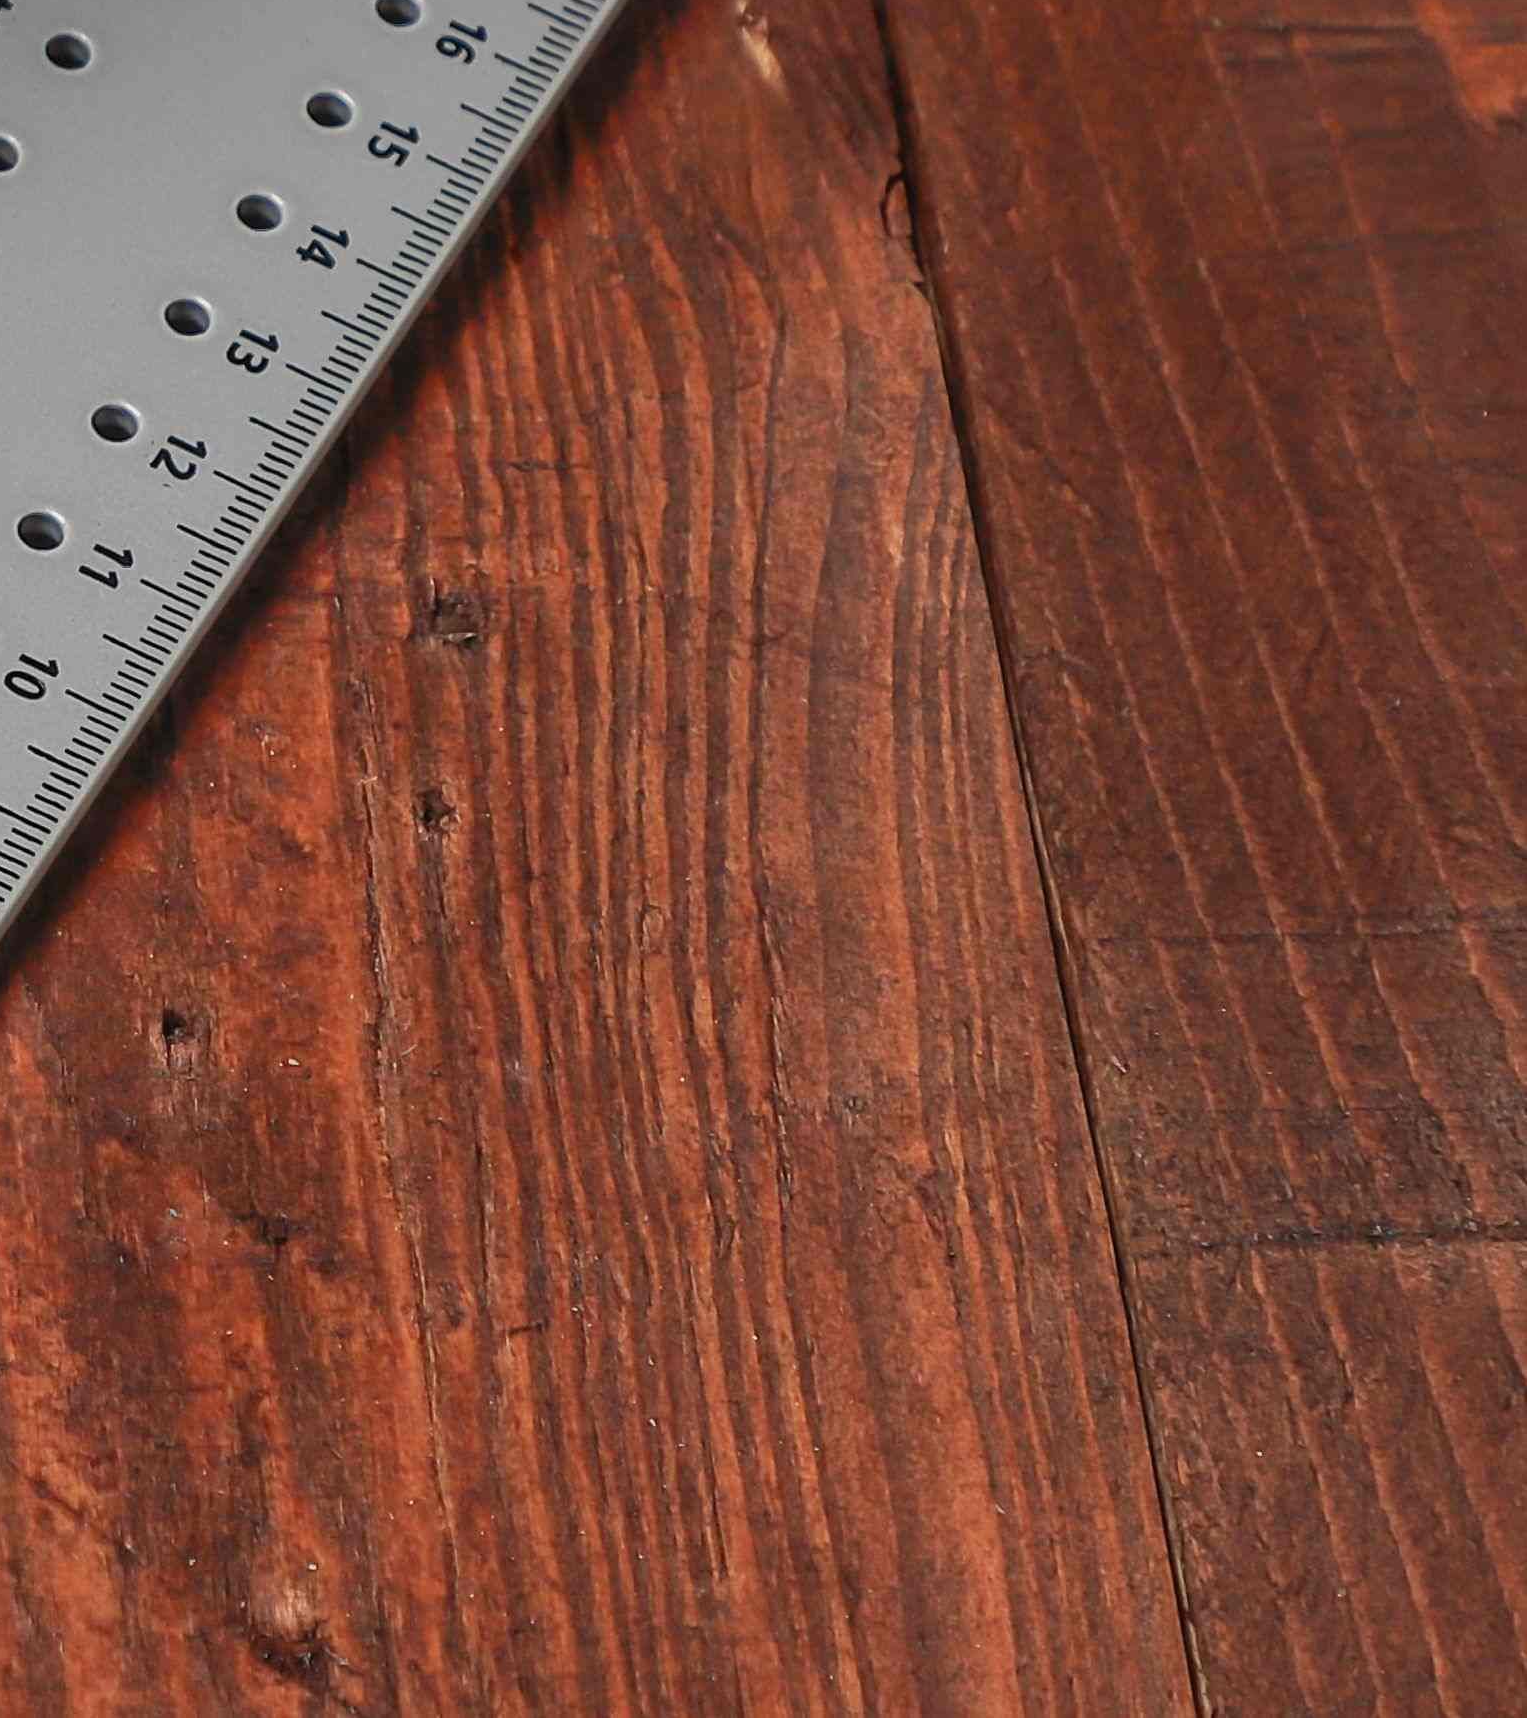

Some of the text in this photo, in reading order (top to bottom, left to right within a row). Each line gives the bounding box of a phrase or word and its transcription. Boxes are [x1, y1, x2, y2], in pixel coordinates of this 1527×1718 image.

[435, 20, 487, 65] 16
[367, 122, 419, 167] 15
[295, 224, 349, 270] 14
[226, 329, 279, 374] 13
[149, 435, 207, 481] 12
[78, 543, 134, 589] 11
[3, 653, 59, 700] 10
